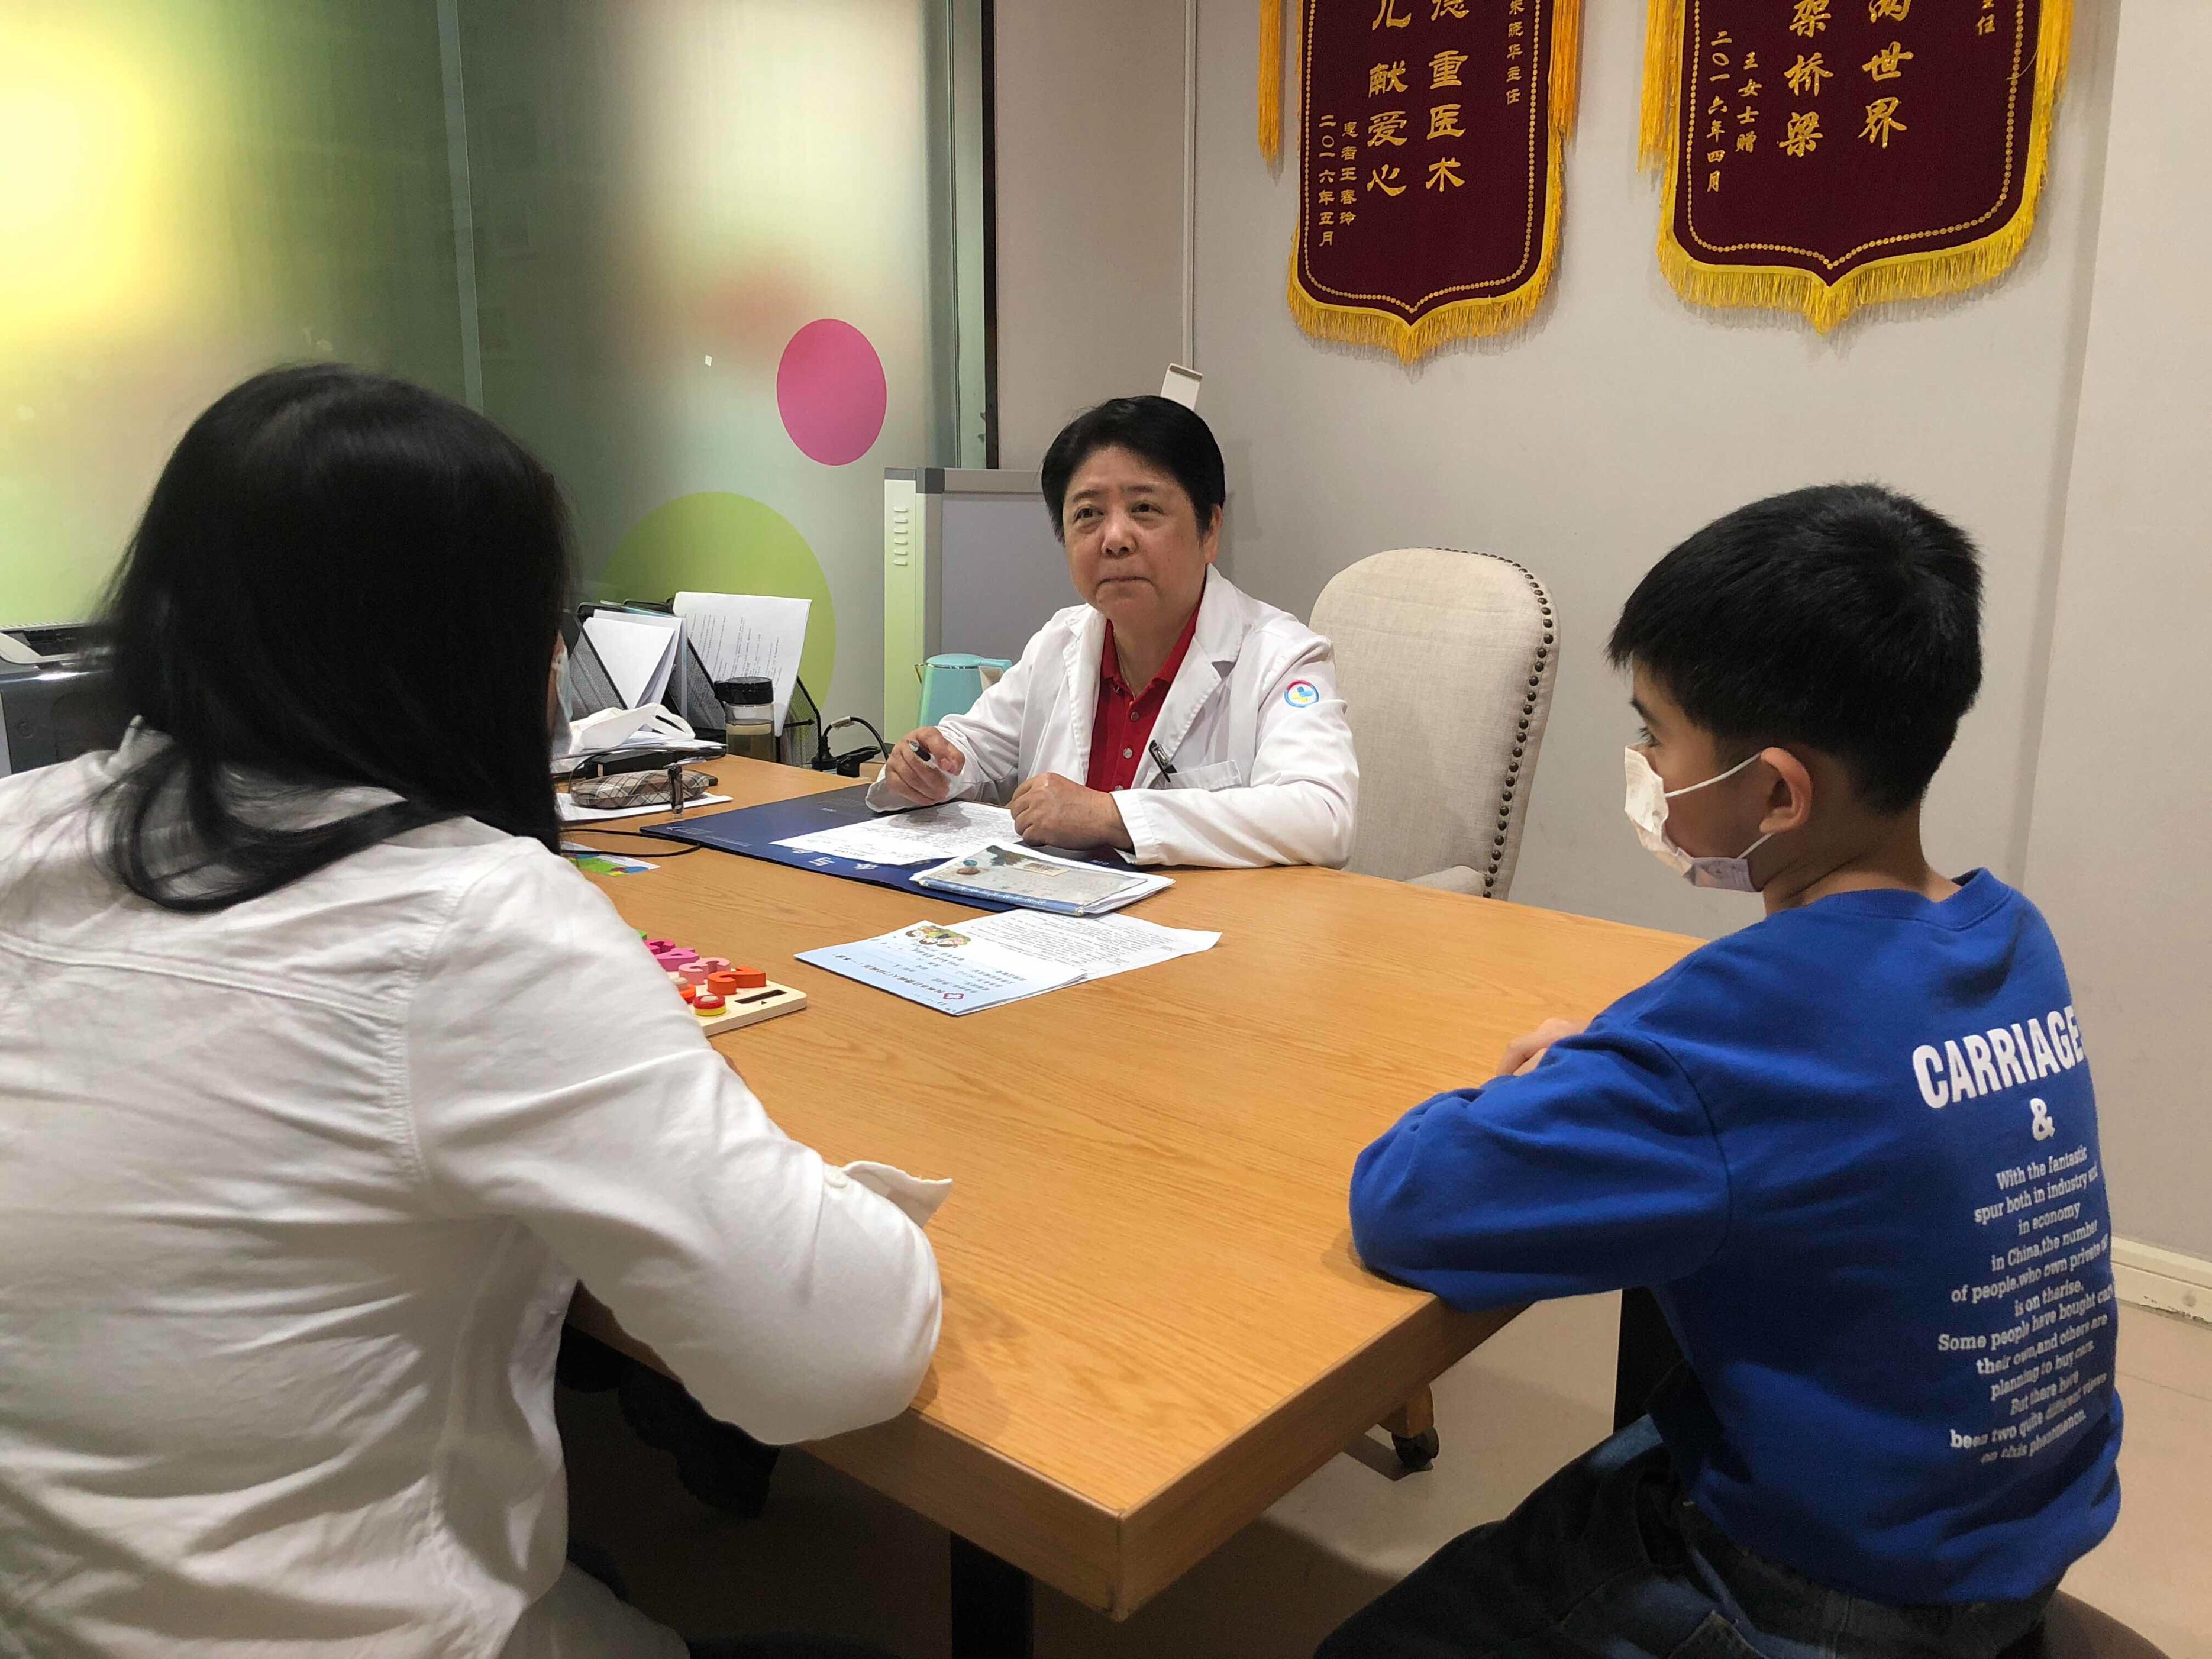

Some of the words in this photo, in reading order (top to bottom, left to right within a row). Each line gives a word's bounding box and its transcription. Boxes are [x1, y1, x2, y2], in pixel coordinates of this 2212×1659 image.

[1735, 51, 1762, 153] 王女士赠
[1913, 1005, 2084, 1109] CARRIAGE
[2030, 1098, 2055, 1141] &
[1996, 1167, 2026, 1190] With
[2027, 1162, 2046, 1180] the
[2049, 1144, 2087, 1173] fantastic
[1975, 1203, 2004, 1225] spur
[2006, 1191, 2032, 1213] both
[2034, 1187, 2045, 1203] in
[2047, 1173, 2087, 1199] industry
[2019, 1219, 2030, 1235] in
[2032, 1202, 2081, 1230] economy
[1991, 1255, 2004, 1271] in
[2062, 1220, 2097, 1247] number
[1951, 1284, 1969, 1302] of
[2044, 1258, 2067, 1277] own
[2069, 1243, 2100, 1271] private
[1938, 1334, 1987, 1351] Some
[2032, 1310, 2056, 1332] have
[2059, 1292, 2095, 1320] bought
[2014, 1300, 2024, 1317] is
[2025, 1295, 2040, 1312] on
[2041, 1361, 2052, 1375] to
[2055, 1351, 2074, 1370] buy
